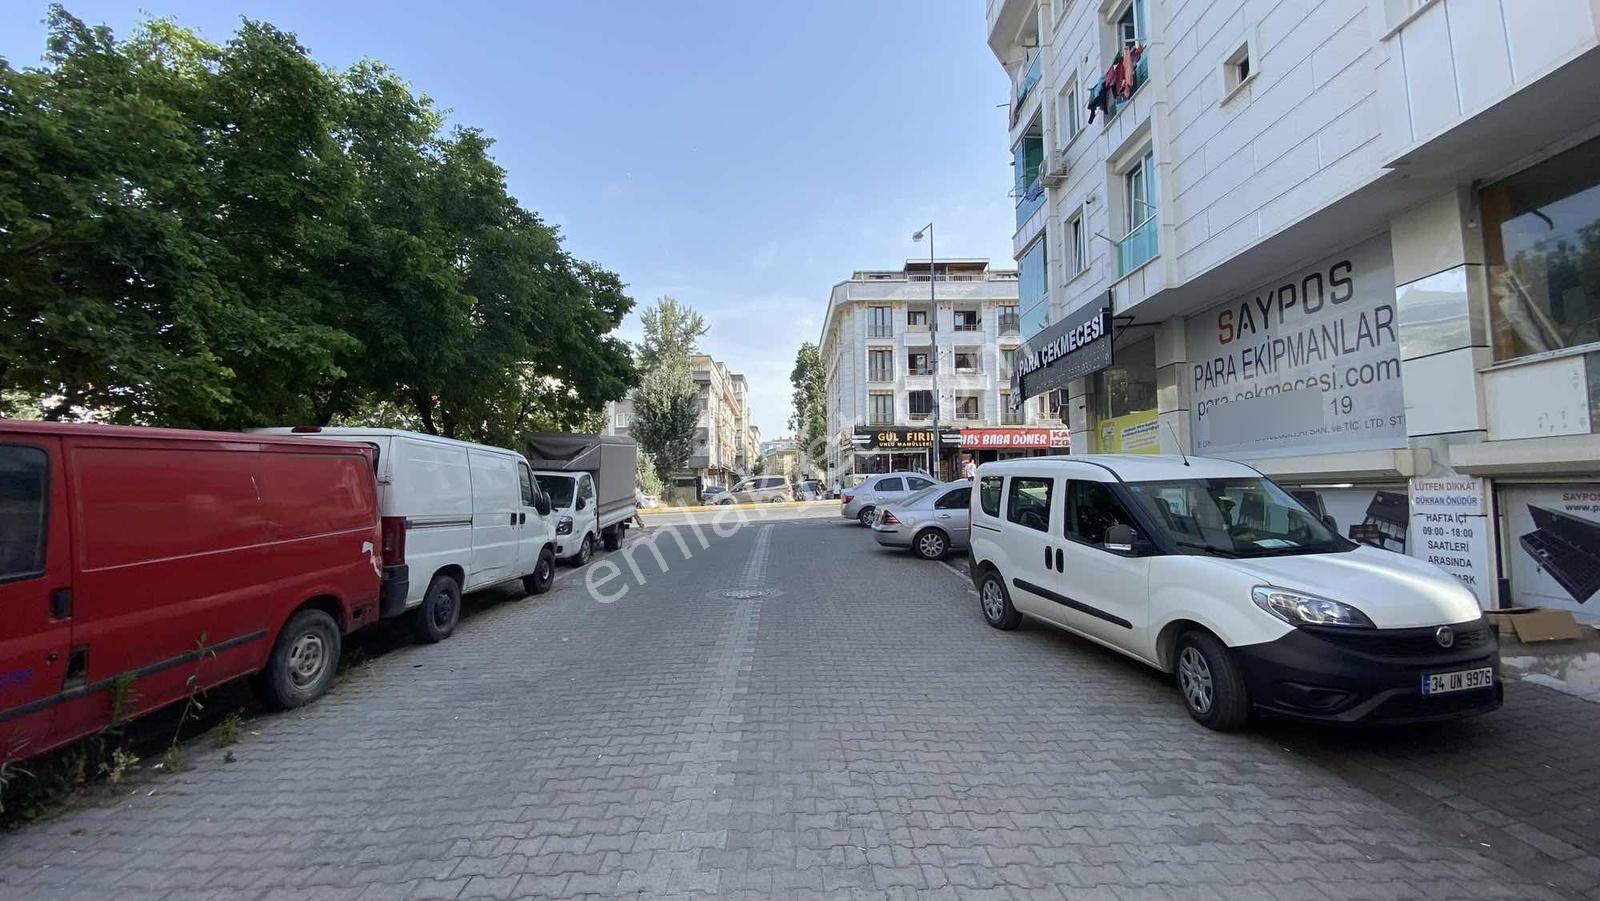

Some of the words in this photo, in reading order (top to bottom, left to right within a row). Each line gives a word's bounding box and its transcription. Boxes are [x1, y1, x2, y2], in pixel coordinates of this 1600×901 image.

[1218, 260, 1353, 345] SAYPOS
[1019, 350, 1040, 377] PARA
[1041, 308, 1104, 369] ÇEKMECESİ
[1194, 354, 1238, 393] PARA
[1242, 304, 1397, 381] EKİPMANLAR
[1330, 395, 1353, 417] 19
[878, 431, 899, 442] GÜL
[983, 434, 1010, 445] BABA
[1013, 431, 1047, 445] DÖNER
[1415, 480, 1444, 491] LÜTFEN
[1447, 481, 1475, 491] DİKKAT
[1564, 504, 1600, 513] www.p
[1426, 514, 1454, 523] HAFTA
[1423, 526, 1444, 536] 09:00
[1452, 528, 1473, 538] 18:00
[1427, 540, 1469, 552] SAATLERİ
[1428, 555, 1473, 568] ARASINDA
[1432, 676, 1444, 691] 34
[1450, 674, 1462, 689] UN
[1466, 670, 1491, 687] 9976
